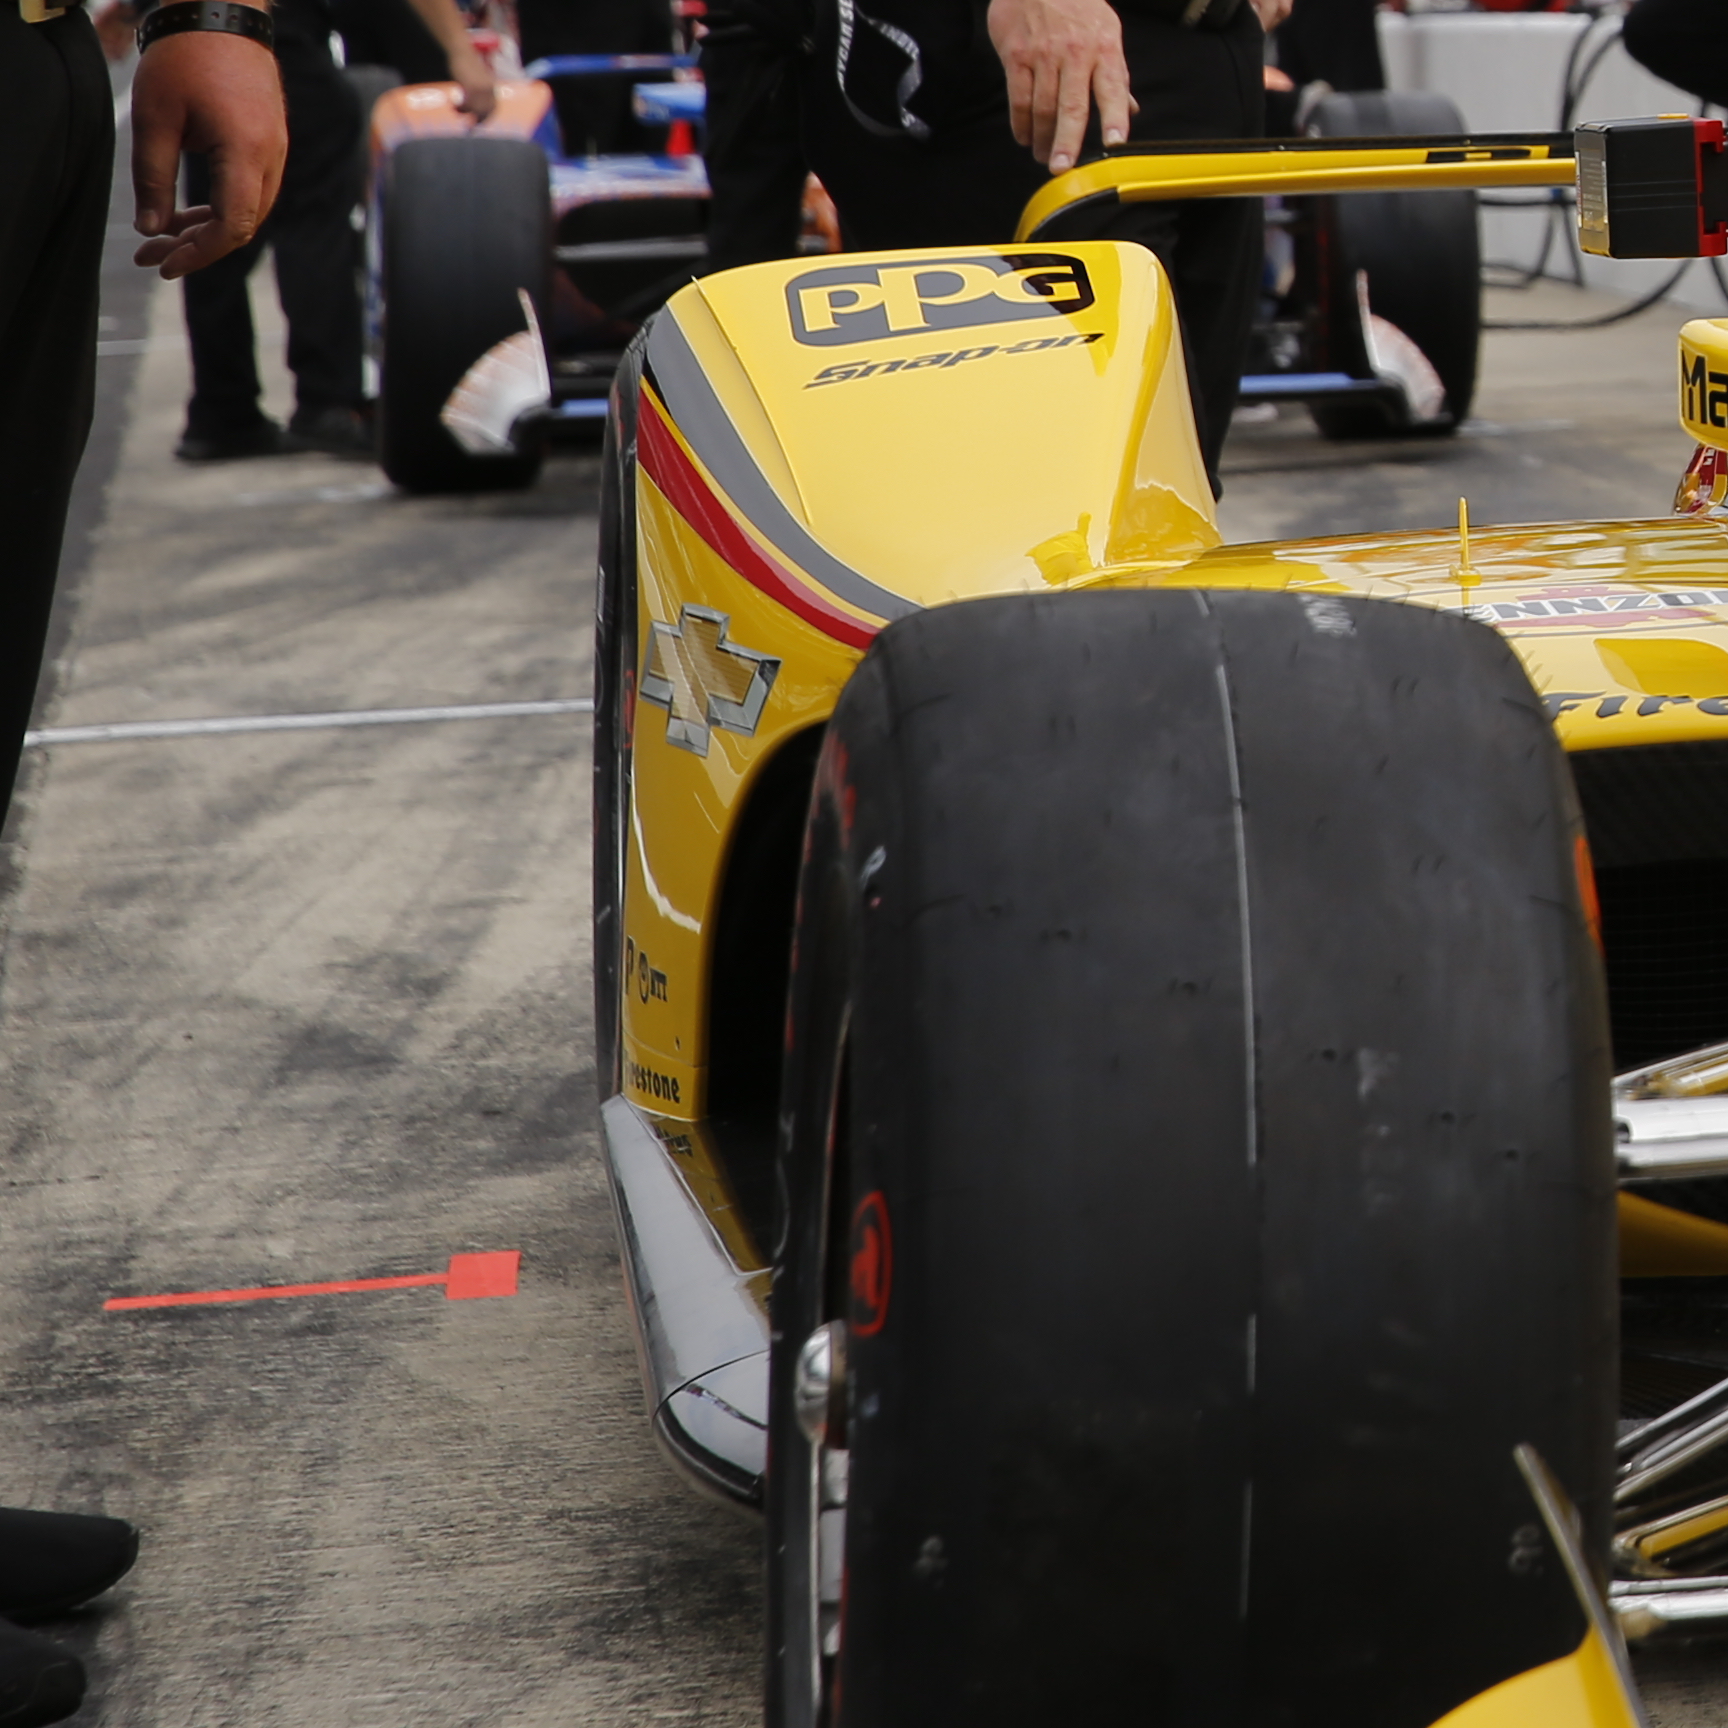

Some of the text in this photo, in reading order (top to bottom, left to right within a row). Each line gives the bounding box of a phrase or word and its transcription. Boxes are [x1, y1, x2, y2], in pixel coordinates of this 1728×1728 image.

[799, 263, 1080, 333] PPG
[803, 332, 1106, 391] Snap-on
[650, 967, 668, 1003] NTT
